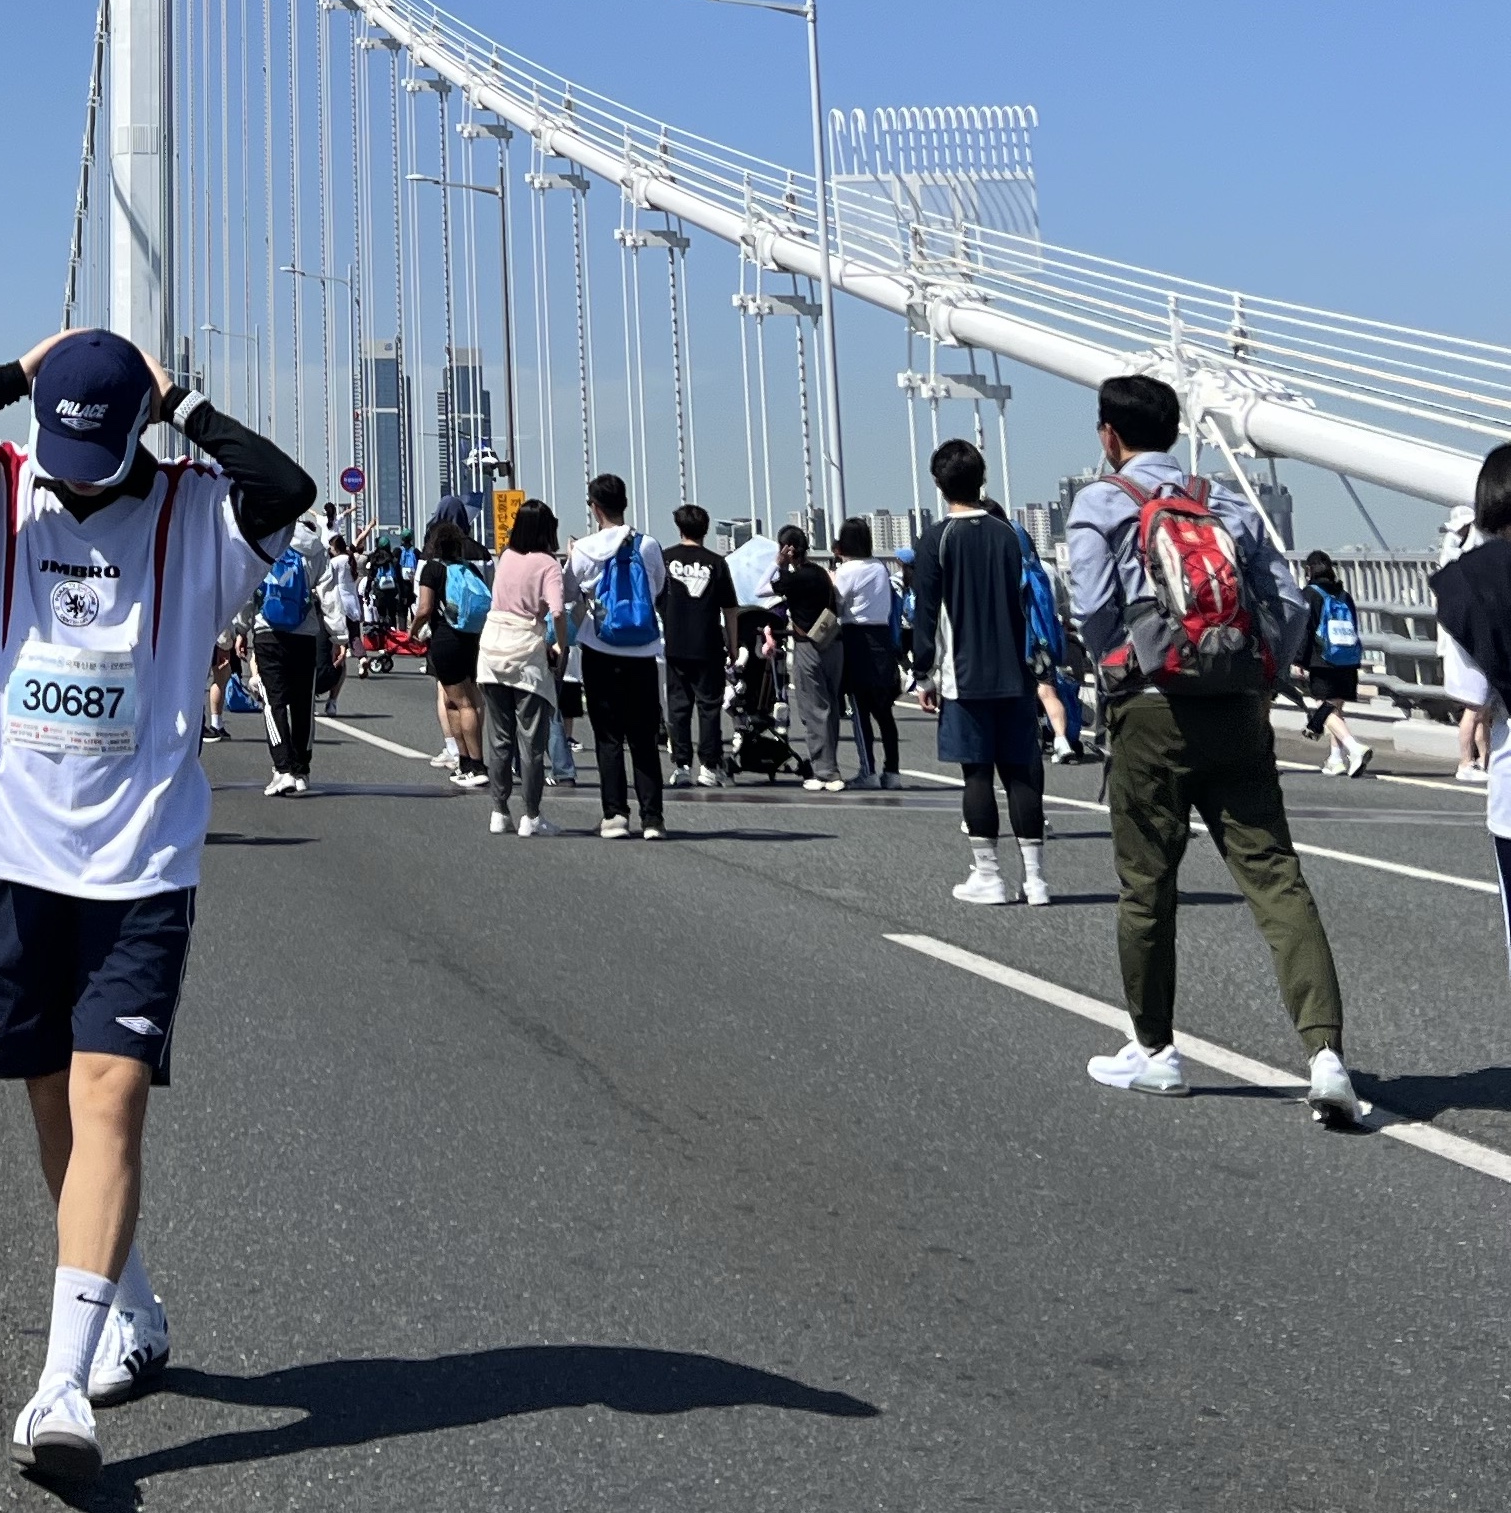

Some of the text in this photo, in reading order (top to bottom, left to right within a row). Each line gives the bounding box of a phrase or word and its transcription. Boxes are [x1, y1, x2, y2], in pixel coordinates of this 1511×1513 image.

[55, 398, 109, 418] PALACE
[669, 559, 711, 579] Gola
[22, 678, 125, 719] 30687
